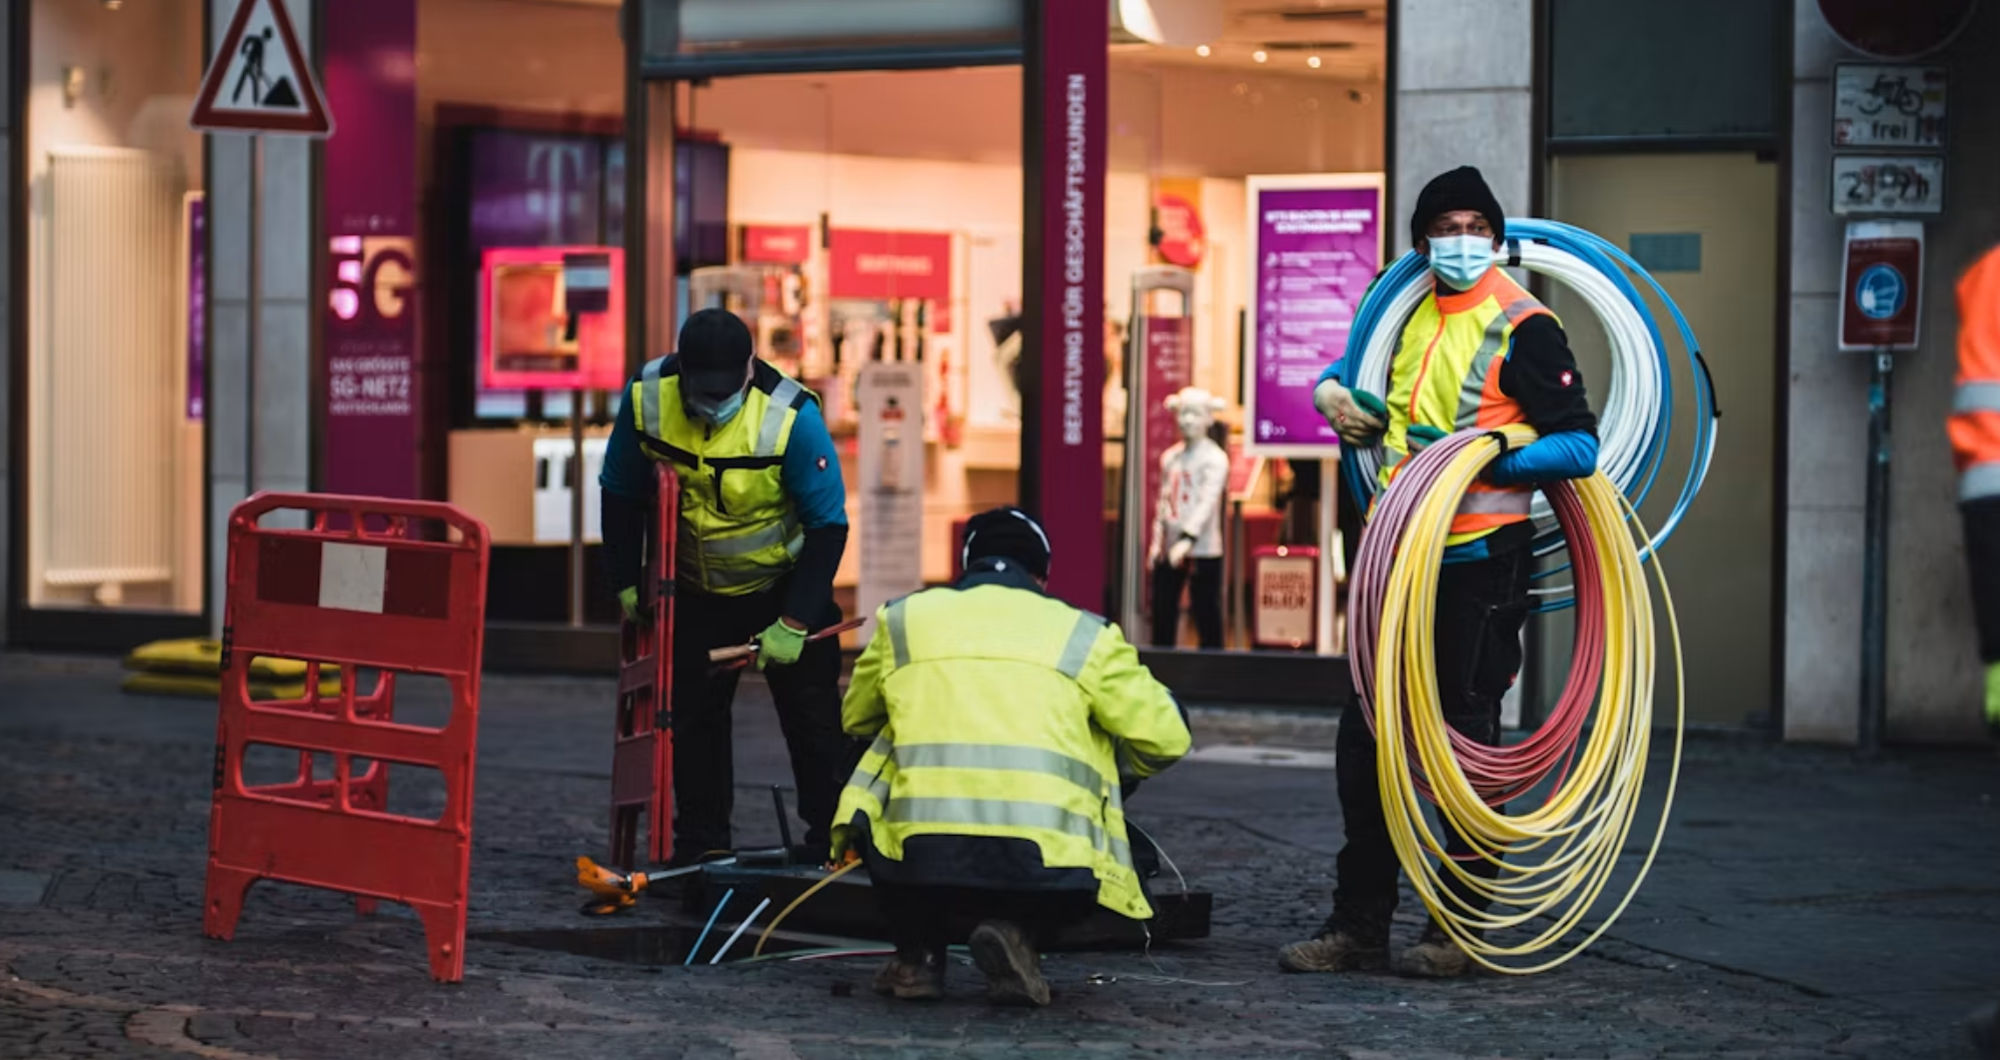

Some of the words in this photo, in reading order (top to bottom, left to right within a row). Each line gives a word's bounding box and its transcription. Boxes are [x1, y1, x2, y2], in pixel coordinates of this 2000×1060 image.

[1872, 120, 1908, 140] frei
[1063, 74, 1087, 284] GESCHÄFTSKUNDEN
[328, 238, 415, 321] 5G
[1061, 285, 1085, 329] FÜR
[330, 375, 410, 399] 5G-NETZ
[1063, 331, 1084, 446] BERATUNG
